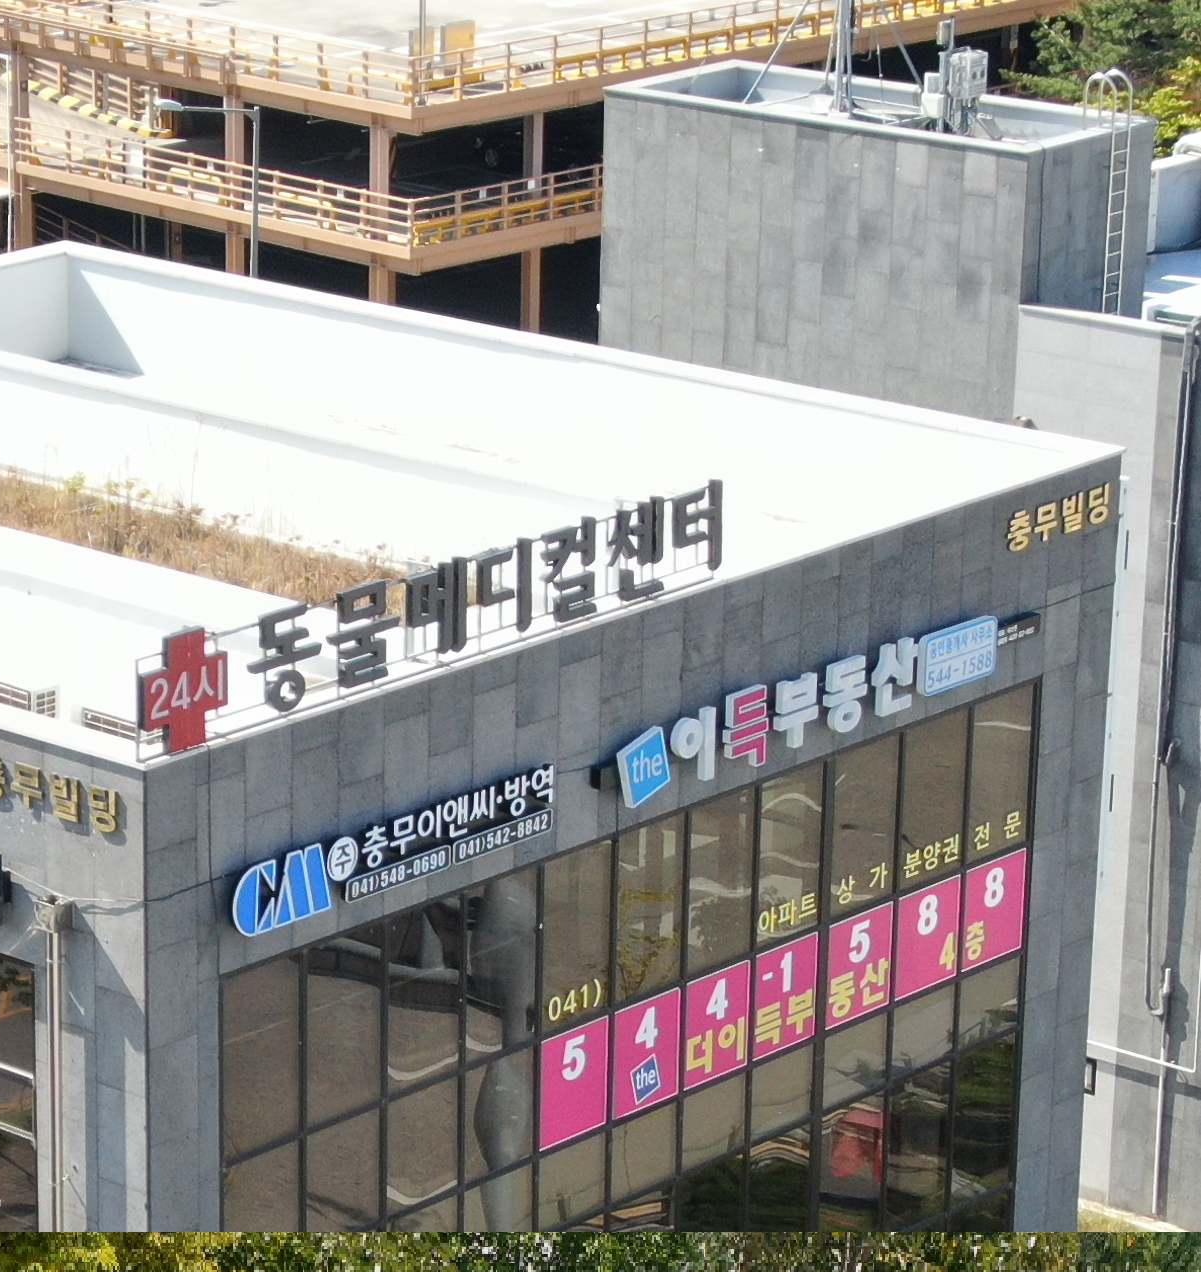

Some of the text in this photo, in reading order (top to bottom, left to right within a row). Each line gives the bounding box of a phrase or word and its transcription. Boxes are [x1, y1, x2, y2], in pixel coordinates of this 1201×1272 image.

[1006, 482, 1112, 553] 충무빌딩
[246, 478, 724, 713] 동물메디컬센터
[149, 652, 227, 720] 24시
[927, 651, 992, 689] 544-1588
[630, 747, 664, 785] the
[758, 893, 818, 933] 아파트
[903, 833, 960, 877] 분양권
[548, 979, 602, 1022] 041)
[635, 1062, 657, 1090] the
